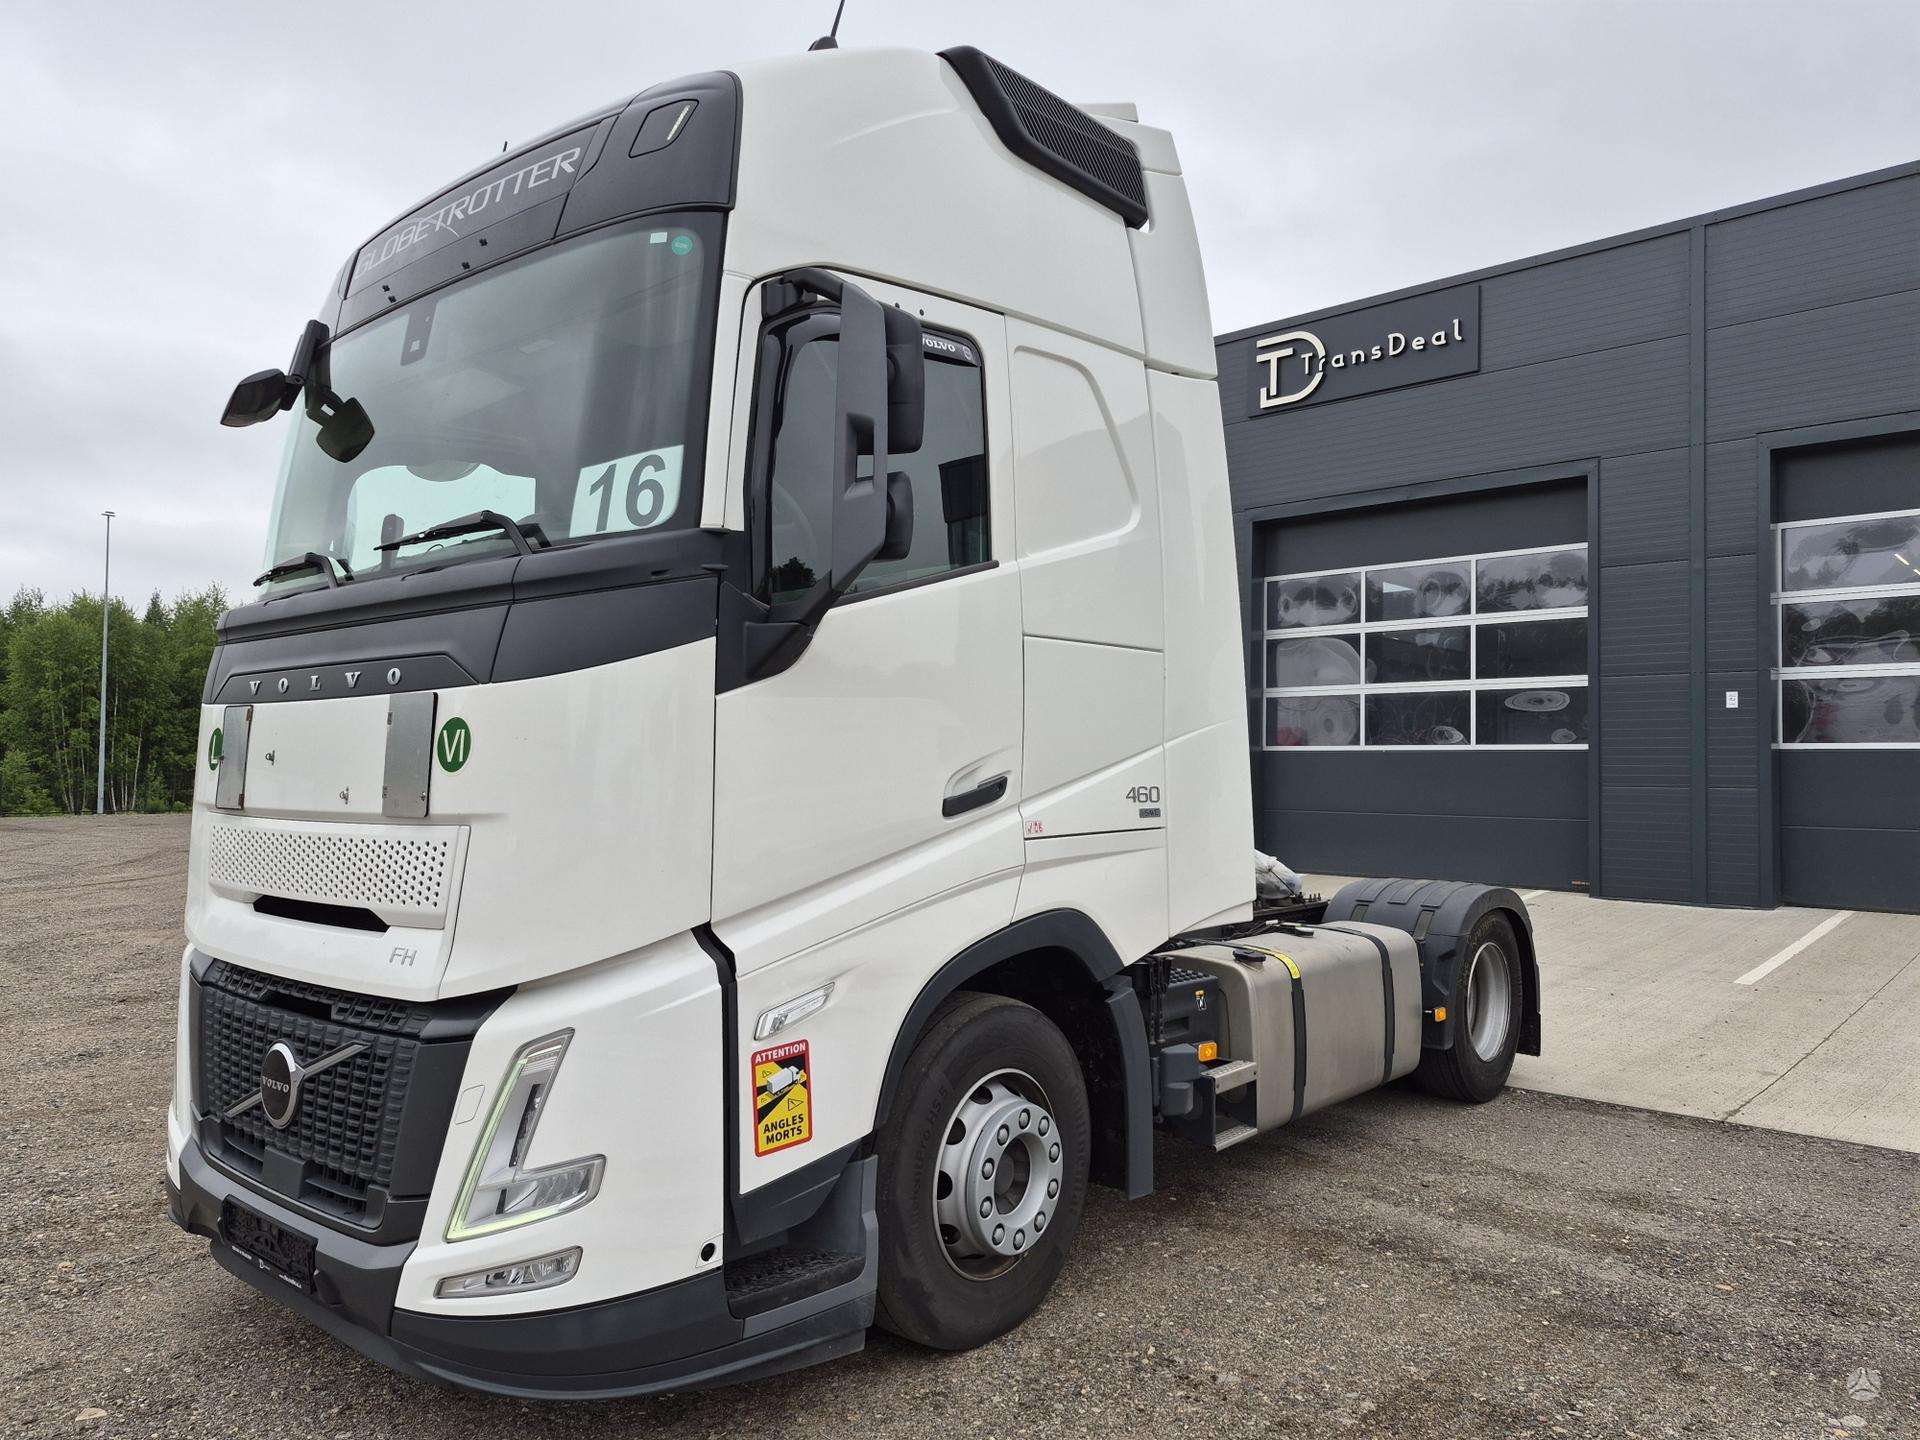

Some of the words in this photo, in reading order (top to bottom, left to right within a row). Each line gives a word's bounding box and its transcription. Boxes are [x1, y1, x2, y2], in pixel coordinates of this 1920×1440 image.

[354, 147, 581, 281] GLOBETROTTER
[1300, 318, 1463, 375] TransDeal
[589, 453, 666, 533] 16
[249, 667, 401, 695] VOLVO
[442, 729, 466, 763] VI
[1125, 786, 1160, 803] 460
[389, 947, 418, 966] FH
[755, 1042, 806, 1064] ATTENTION
[262, 1076, 289, 1093] VOLVO
[763, 1113, 804, 1135] ANGLES
[766, 1125, 803, 1145] MORTS
